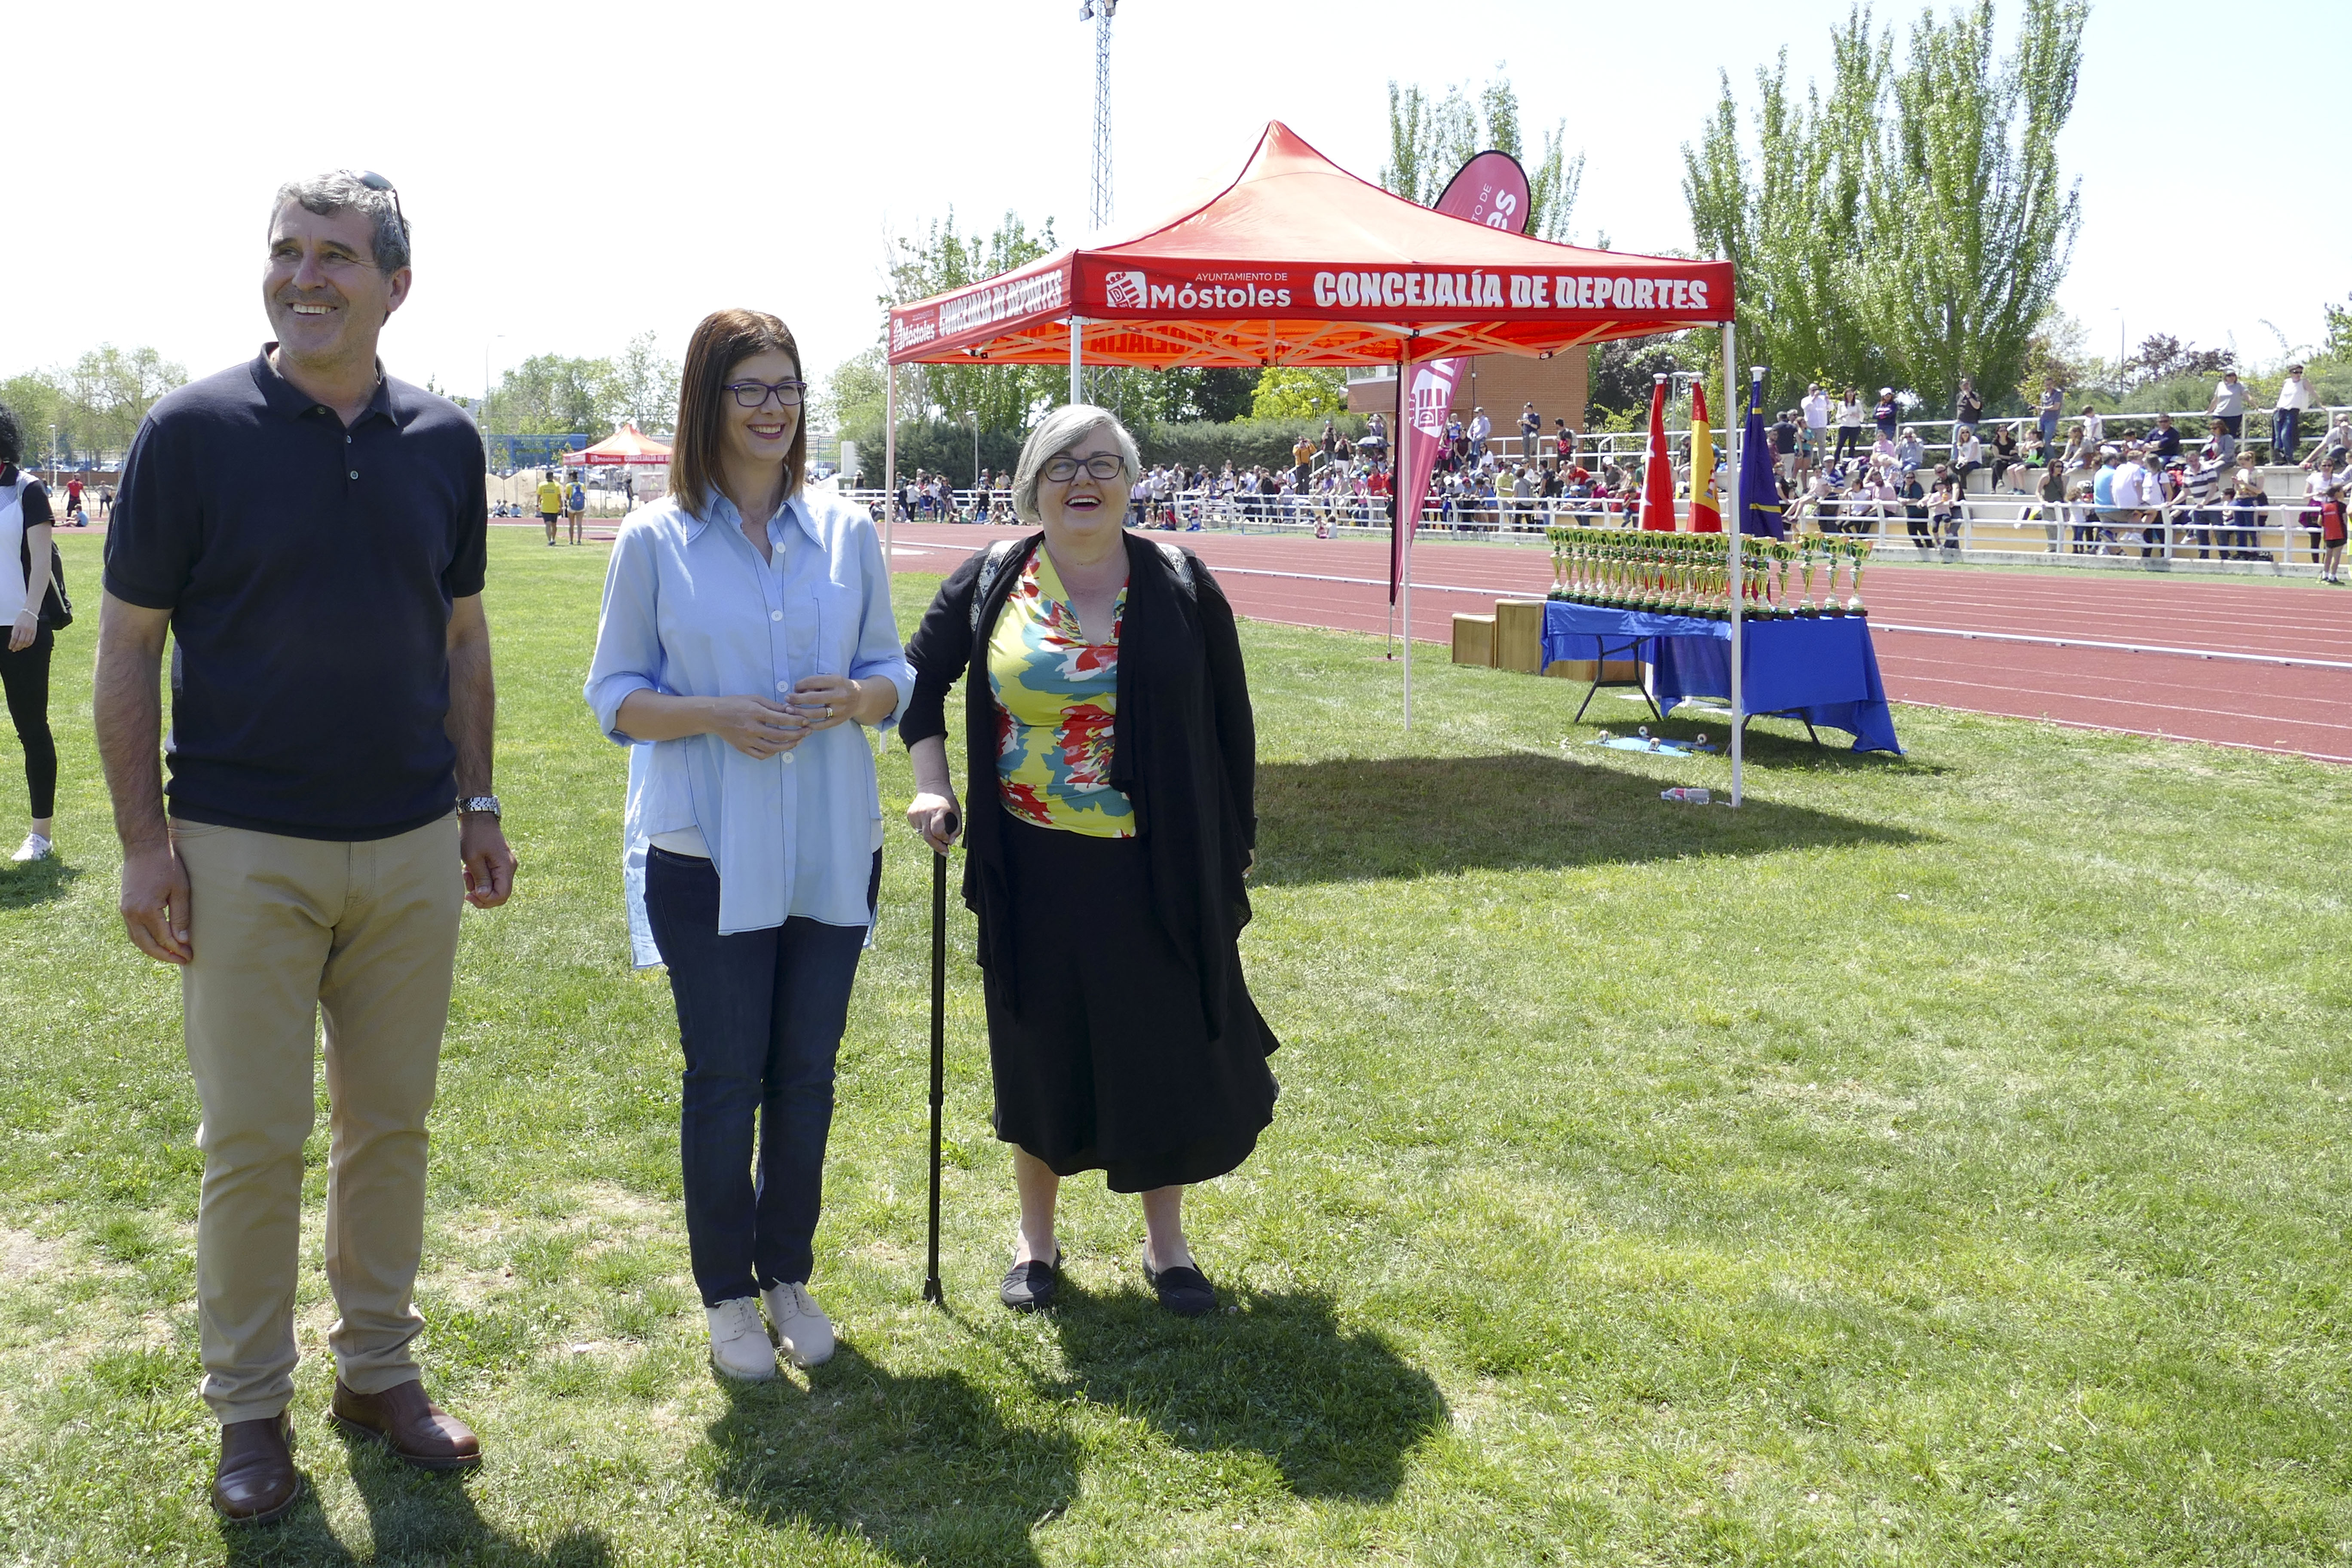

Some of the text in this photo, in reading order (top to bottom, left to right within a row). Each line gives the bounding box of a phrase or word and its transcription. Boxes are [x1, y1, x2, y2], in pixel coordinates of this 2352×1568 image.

[1479, 183, 1492, 202] DE
[1195, 273, 1287, 281] AYUNTAMIENTO DE
[1313, 270, 1708, 309] CONCEJALÍA DE DEPORTES
[939, 269, 1063, 337] CONCEJALÍA DE DEPORTES
[1151, 283, 1291, 309] Móstoles
[903, 320, 935, 348] Móstoles
